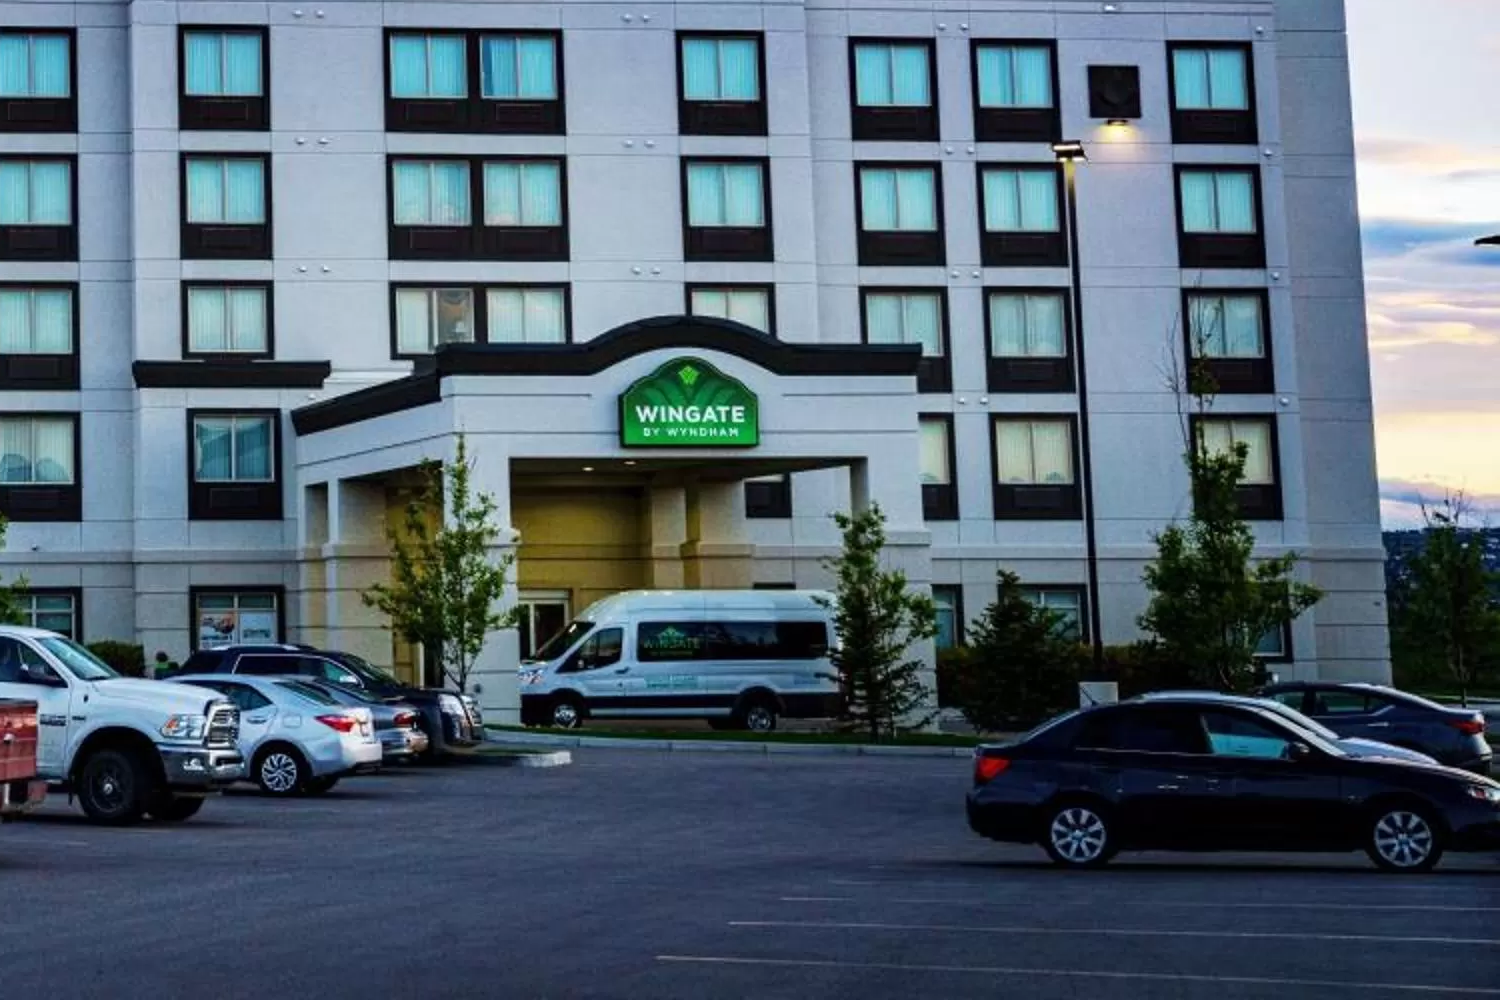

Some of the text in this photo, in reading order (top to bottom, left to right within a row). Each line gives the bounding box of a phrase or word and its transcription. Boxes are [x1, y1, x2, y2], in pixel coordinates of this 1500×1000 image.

[635, 405, 745, 423] WINGATE
[643, 427, 740, 437] BY WYNDHAM
